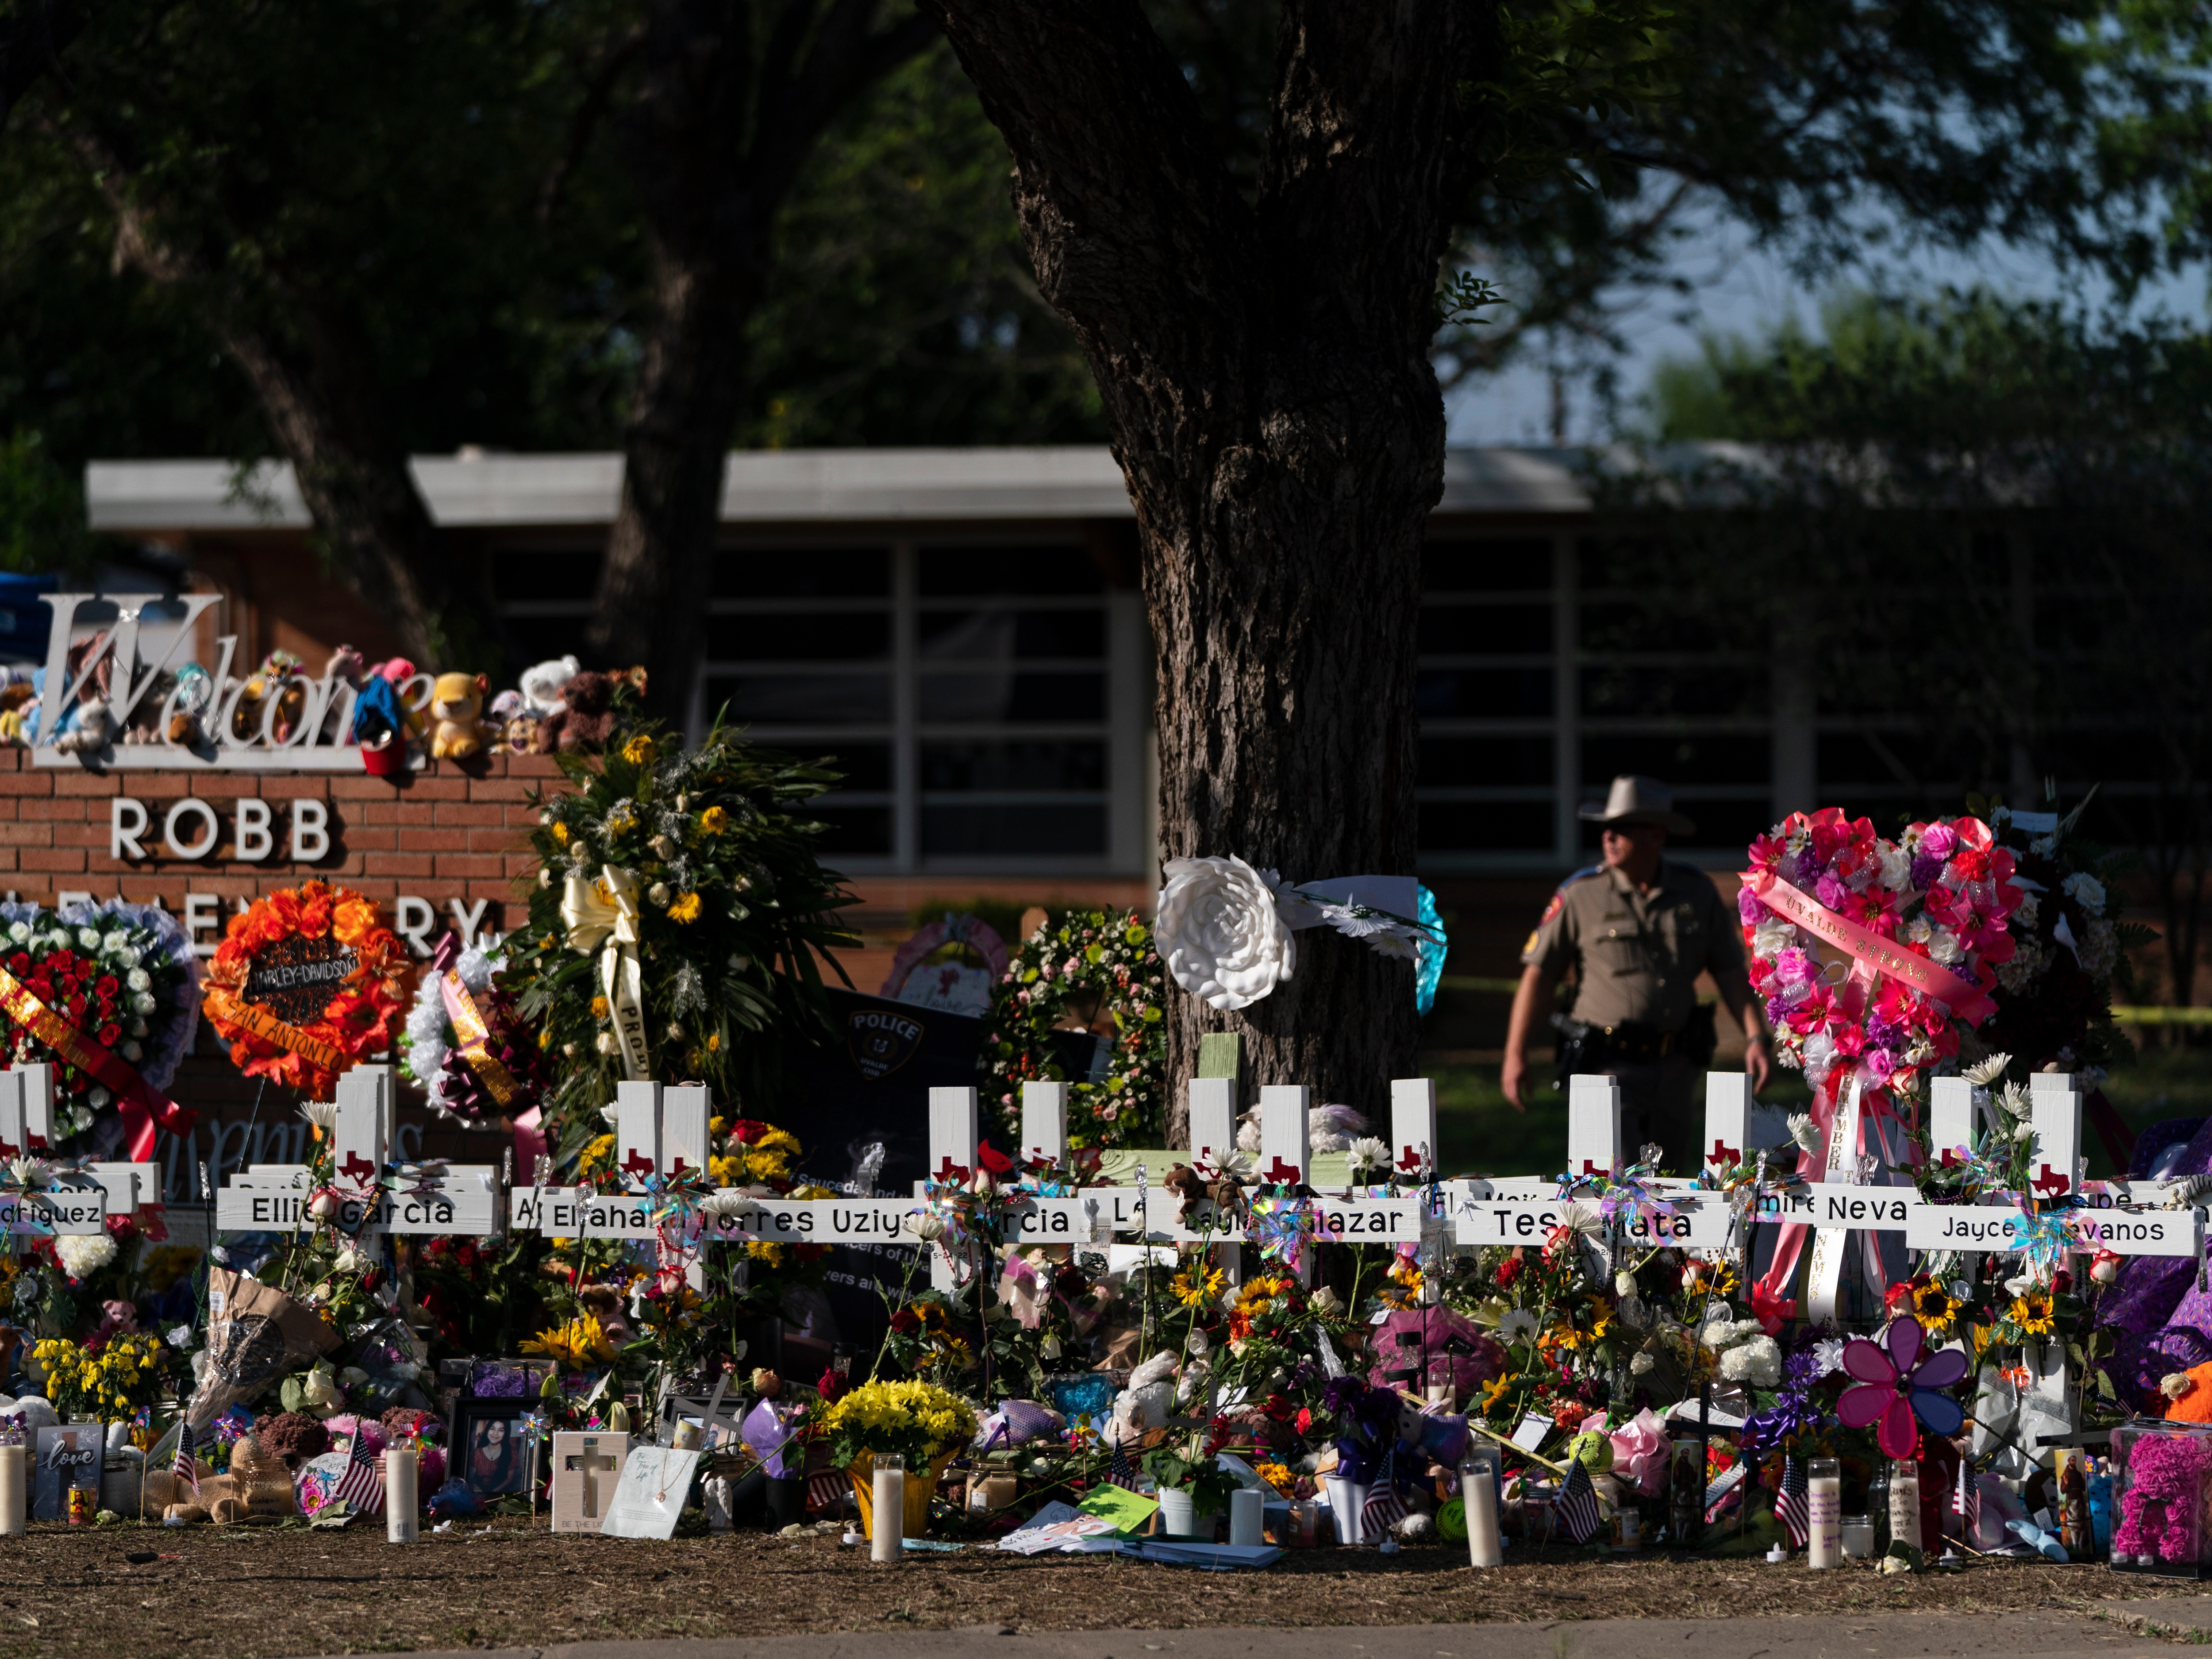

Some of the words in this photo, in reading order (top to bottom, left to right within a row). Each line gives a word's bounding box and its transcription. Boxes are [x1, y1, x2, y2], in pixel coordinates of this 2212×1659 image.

[111, 797, 331, 861] ROBB
[1786, 894, 1848, 942] UVALDE
[1856, 939, 1928, 983] STRONG
[223, 1000, 263, 1031] SAN
[265, 1022, 344, 1071] ANTONIO
[854, 1014, 919, 1040] POLICE
[861, 1058, 889, 1070] UVALDE
[864, 1067, 880, 1076] CISD
[1, 1205, 100, 1227] driguez
[253, 1197, 315, 1223] Ellie
[341, 1199, 453, 1224] Garcia
[1829, 1196, 1908, 1221] Neva
[1493, 1209, 1558, 1236] Tes
[1943, 1216, 2016, 1241] Jayce
[2069, 1223, 2165, 1240] evanos
[887, 1248, 902, 1260] of
[1809, 1234, 1827, 1301] NAMES
[1686, 1402, 1733, 1425] Ualde
[37, 1440, 95, 1470] love
[637, 1460, 649, 1470] Tree
[650, 1463, 658, 1474] of
[635, 1471, 649, 1482] Life
